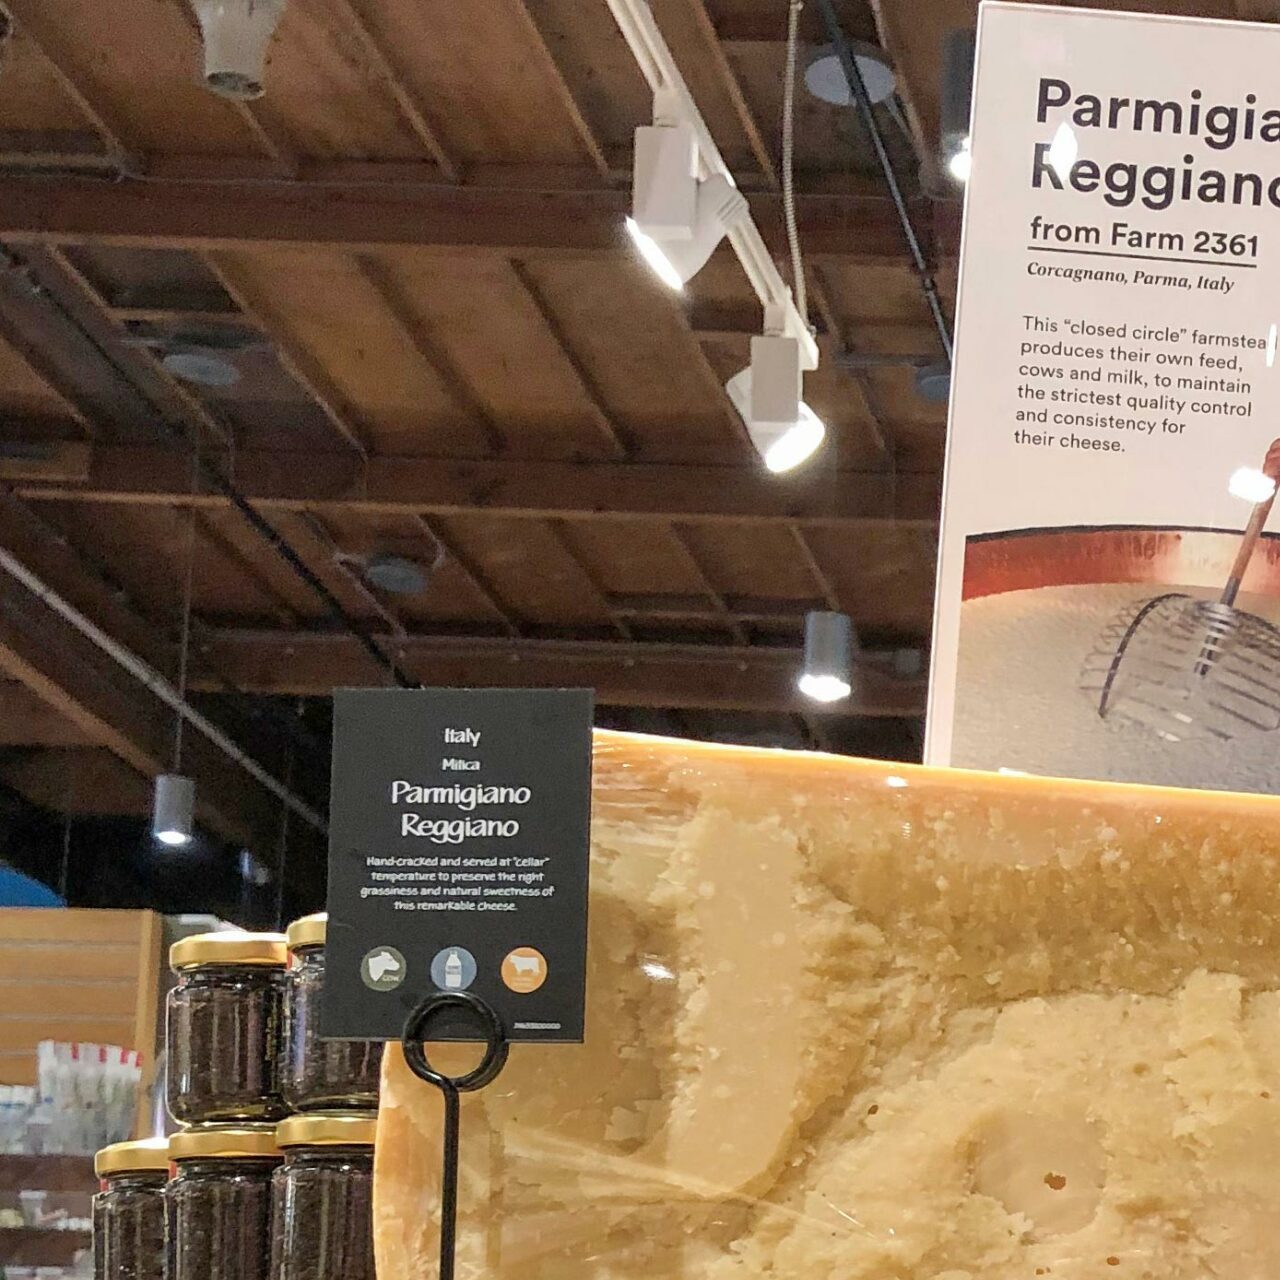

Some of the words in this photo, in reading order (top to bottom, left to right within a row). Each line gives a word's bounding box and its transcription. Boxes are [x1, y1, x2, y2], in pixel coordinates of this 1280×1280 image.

[1030, 215, 1100, 244] from
[1111, 222, 1184, 251] Farm
[1194, 231, 1258, 257] 2361
[1027, 261, 1128, 284] Corcagnano,
[1133, 270, 1192, 289] Parma,
[1197, 276, 1235, 294] Italy
[1022, 315, 1058, 333] This
[1192, 330, 1277, 350] farmstea
[1020, 340, 1104, 360] produces
[1110, 346, 1150, 362] their
[1156, 353, 1193, 366] own
[1199, 353, 1243, 372] feed,
[1018, 364, 1064, 379] cows
[1070, 367, 1101, 382] and
[1107, 370, 1148, 387] milk,
[1154, 373, 1172, 387] to
[1177, 376, 1251, 394] maintain
[1018, 384, 1046, 400] the
[1051, 386, 1121, 406] strictest
[1126, 395, 1186, 415] quality
[1191, 401, 1252, 417] control
[1015, 408, 1047, 423] and
[1053, 411, 1156, 434] consistency
[1161, 418, 1186, 434] for
[1014, 430, 1055, 446] their
[1060, 433, 1126, 452] cheese.
[444, 728, 481, 747] Italy
[391, 780, 532, 811] Parmigiano
[401, 813, 520, 844] Reggiano
[440, 856, 461, 867] and
[463, 857, 498, 867] served
[499, 857, 511, 867] at
[360, 887, 418, 898] grassiness
[420, 886, 441, 896] and
[443, 886, 481, 896] natural
[483, 887, 540, 897] sweetness
[541, 886, 555, 897] of
[371, 871, 436, 883] temperature
[438, 872, 449, 882] to
[451, 872, 496, 883] preserve
[498, 871, 517, 882] the
[518, 871, 544, 884] right
[394, 901, 415, 911] this
[417, 901, 475, 911] remarkable
